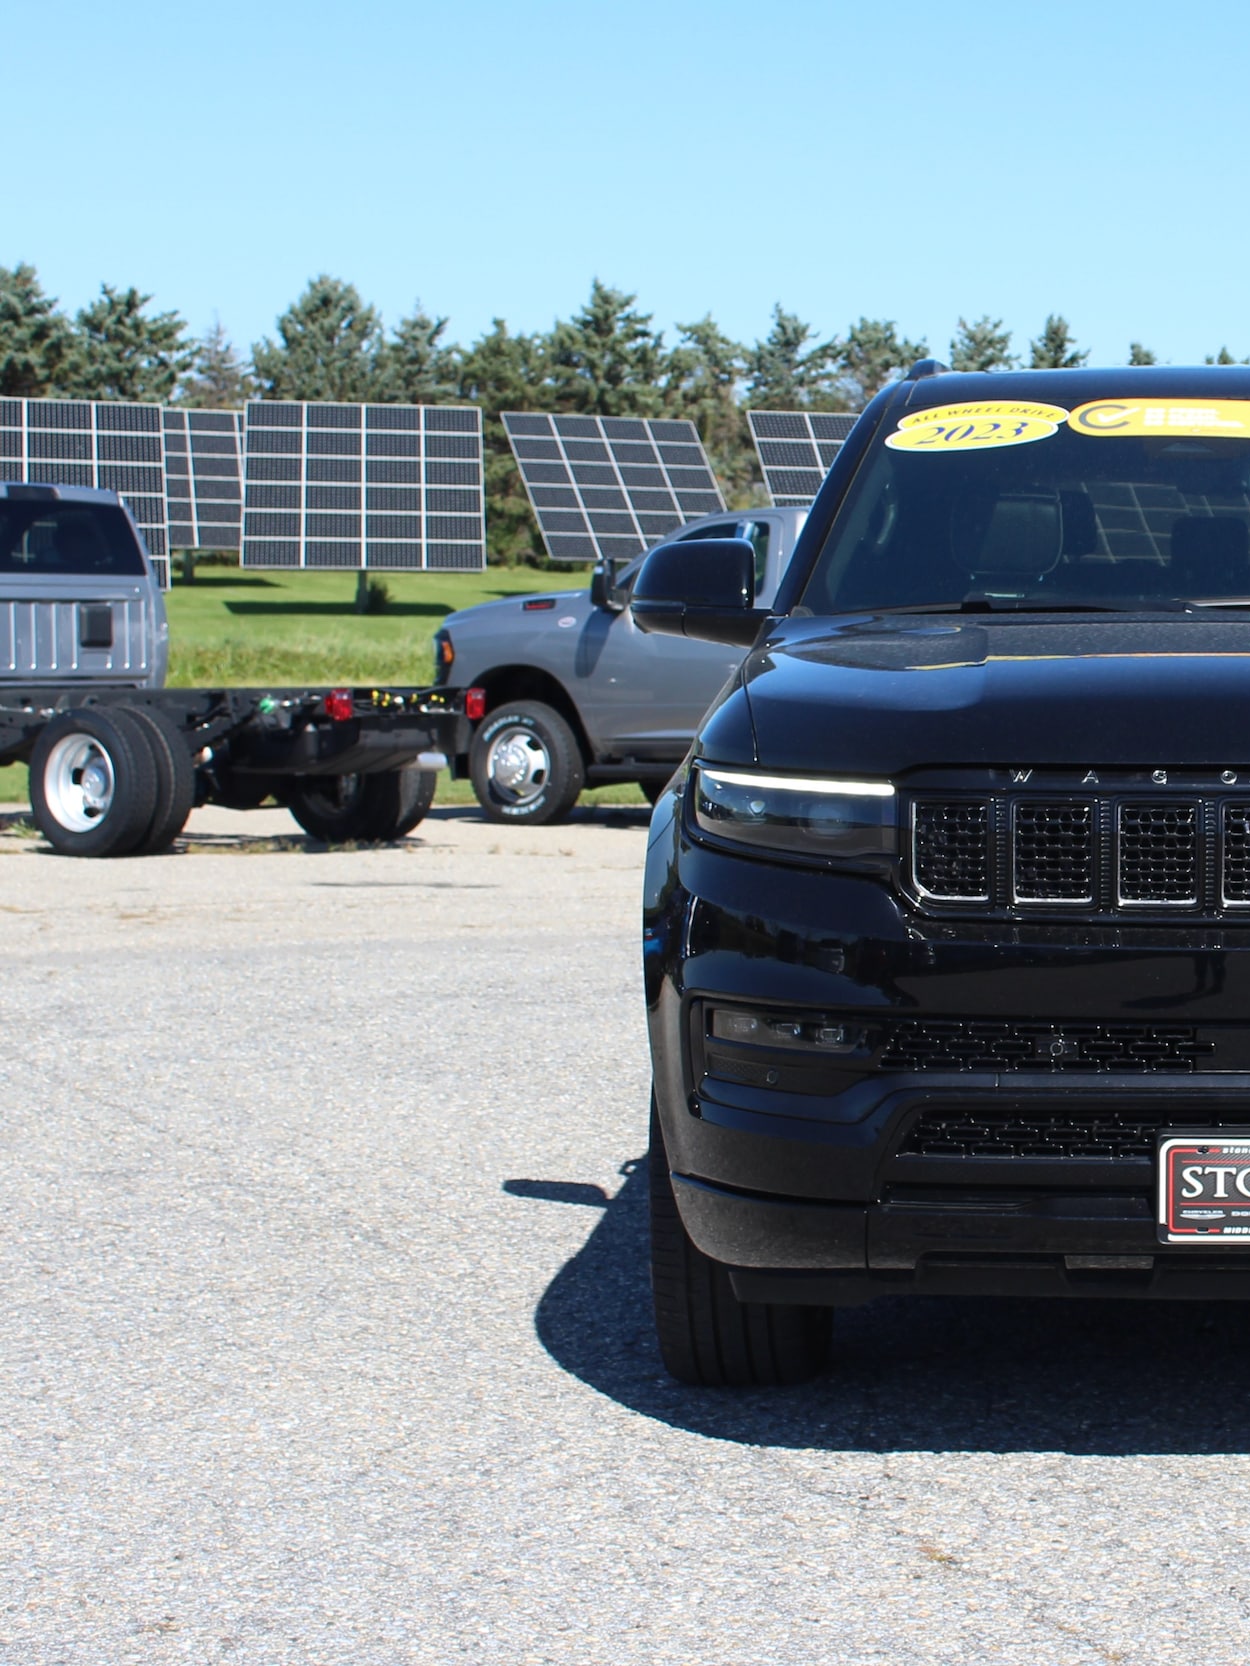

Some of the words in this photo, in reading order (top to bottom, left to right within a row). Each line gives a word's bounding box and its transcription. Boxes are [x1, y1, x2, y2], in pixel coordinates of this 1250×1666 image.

[912, 413, 939, 424] ALL
[948, 407, 1002, 416] WHEEL
[1009, 408, 1057, 418] DRIVE
[911, 422, 1029, 445] 2023
